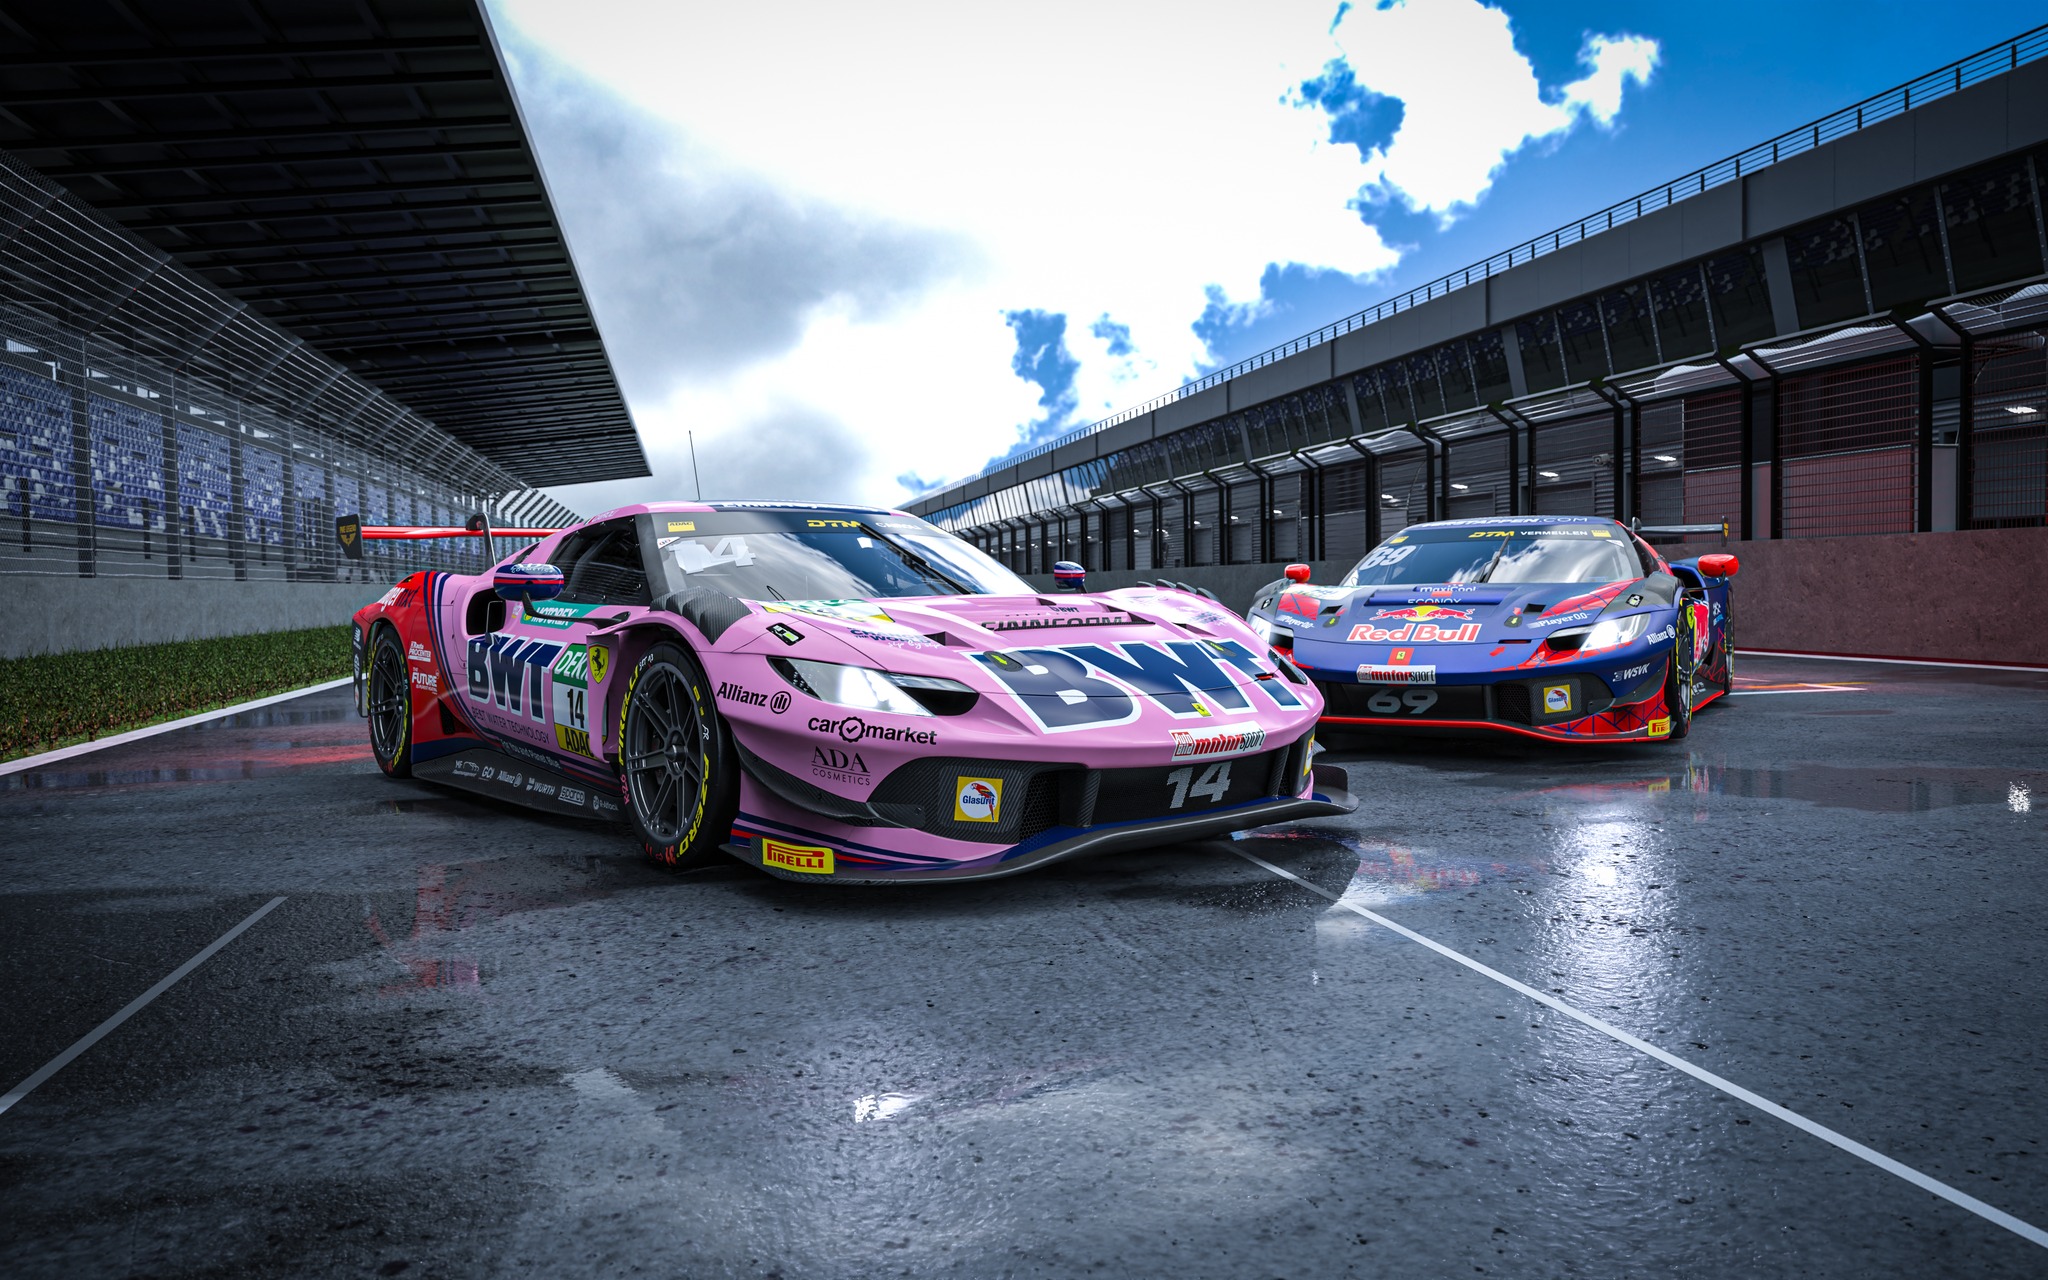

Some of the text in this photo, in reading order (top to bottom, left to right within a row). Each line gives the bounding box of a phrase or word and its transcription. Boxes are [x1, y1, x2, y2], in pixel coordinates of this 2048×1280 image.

[806, 519, 862, 528] DTM
[1468, 530, 1515, 538] DTM
[1358, 545, 1417, 571] 69
[1346, 623, 1482, 642] Red Bull
[1646, 631, 1669, 645] Allianz
[411, 671, 438, 687] FUTURE
[466, 631, 568, 725] BWT
[1623, 663, 1651, 680] WSVK
[716, 681, 768, 708] Allianz
[966, 640, 1309, 734] BWT
[566, 688, 585, 729] 14
[1367, 687, 1439, 715] 69
[471, 706, 550, 744] BEST WATER TECHNOLOGY
[618, 664, 639, 767] PIRELLI
[807, 716, 937, 746] car market
[1174, 732, 1193, 745] Auto
[1193, 728, 1265, 755] motorsport
[812, 745, 870, 774] ADA
[497, 770, 516, 784] Allianz
[812, 767, 871, 786] COSMETICS
[1166, 761, 1233, 809] 14
[560, 787, 586, 803] sparco
[962, 793, 996, 806] Glasurit
[766, 842, 826, 869] PIRELLI
